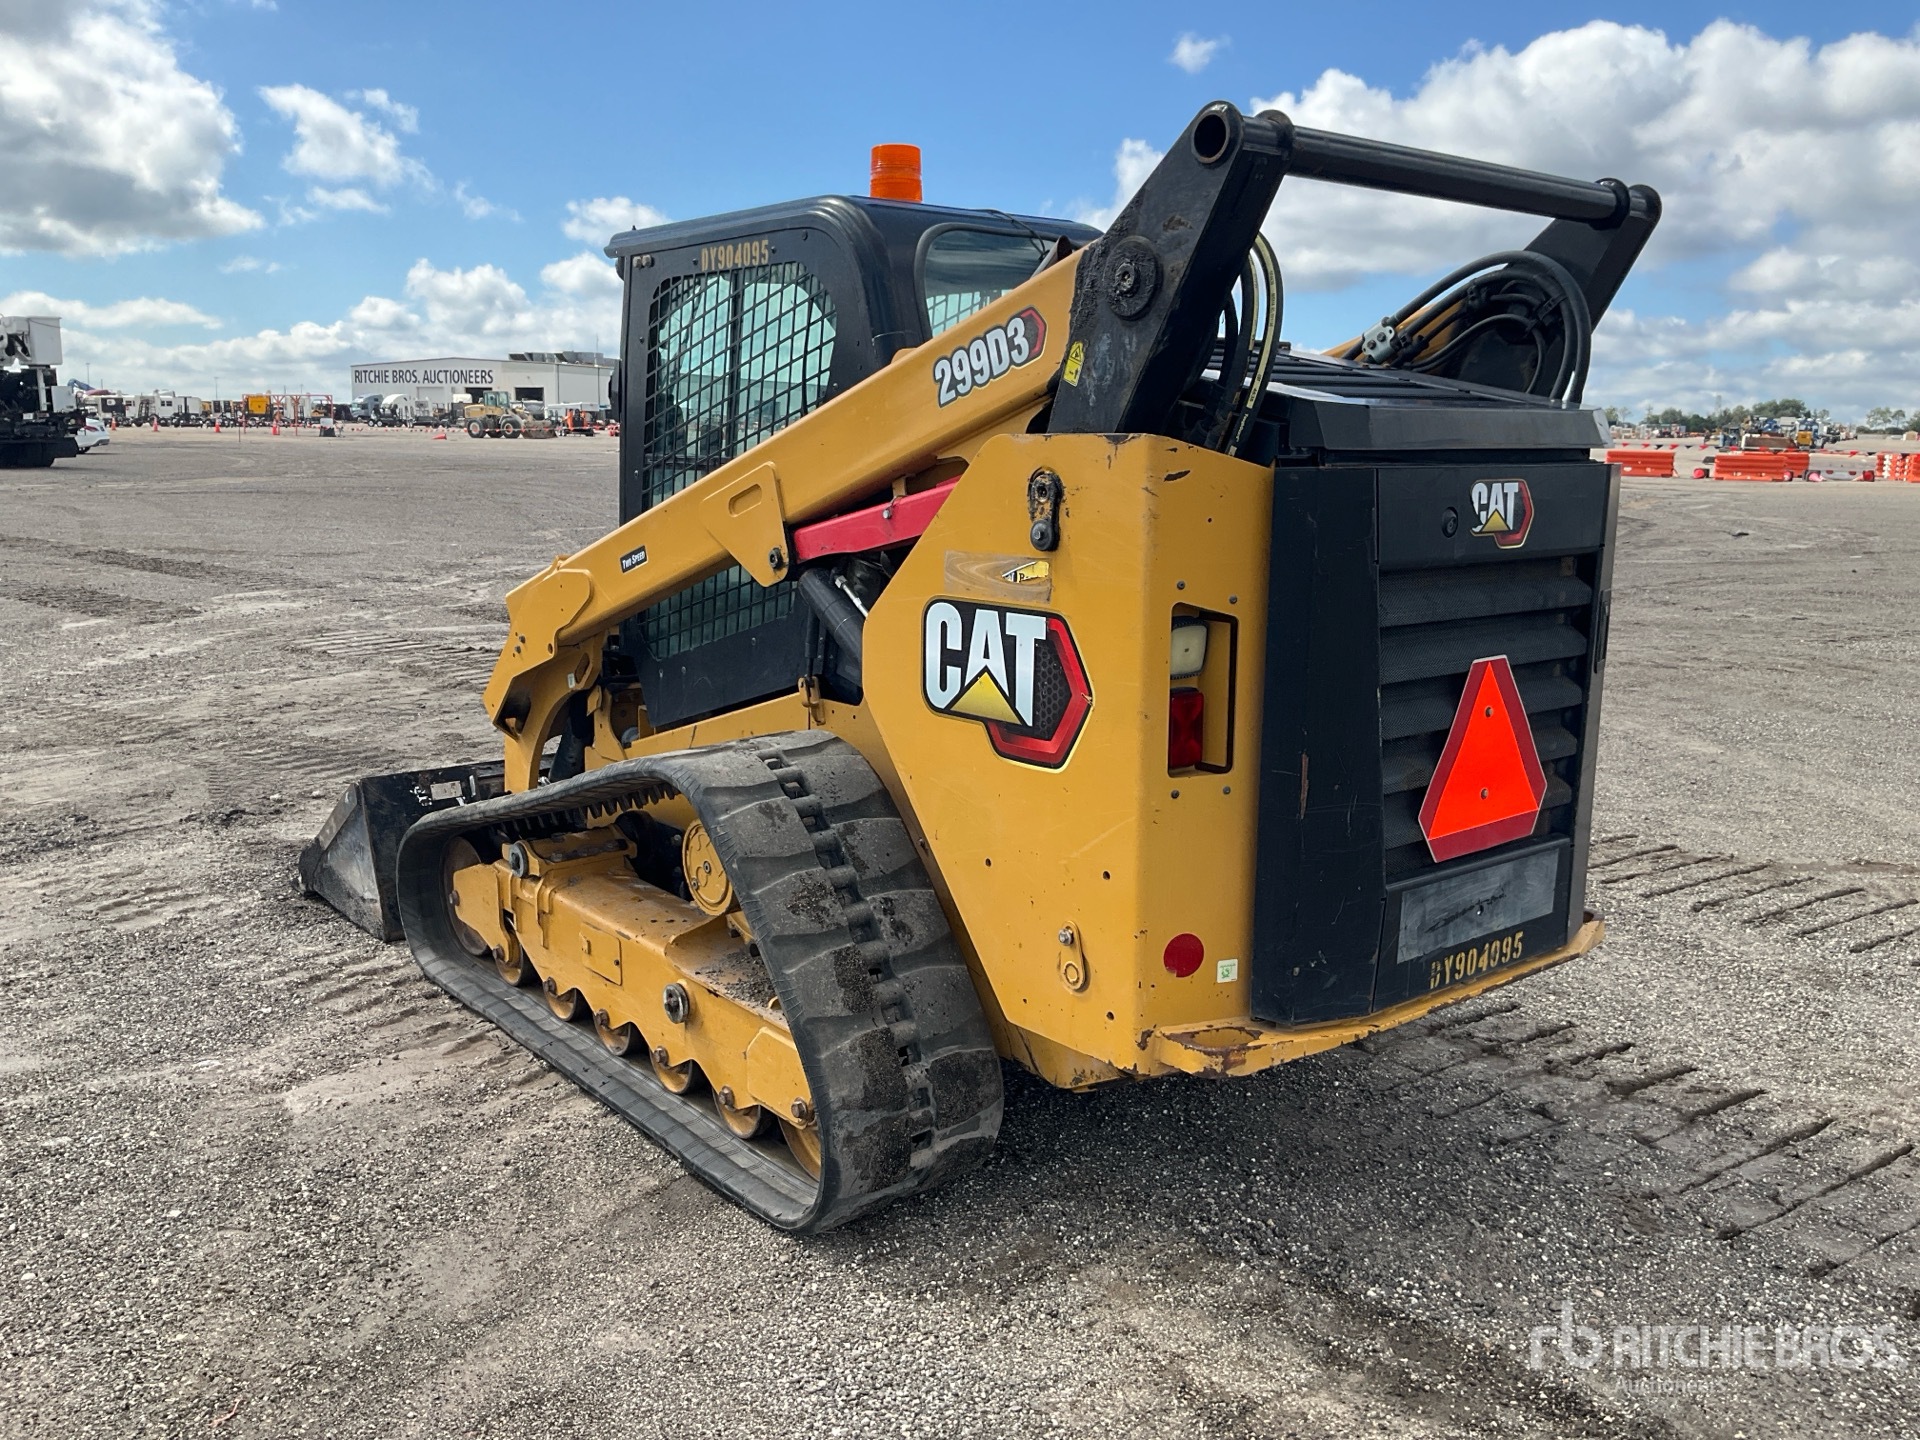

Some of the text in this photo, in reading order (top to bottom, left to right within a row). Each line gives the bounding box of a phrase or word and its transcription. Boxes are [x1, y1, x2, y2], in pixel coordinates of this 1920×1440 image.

[701, 239, 769, 272] DY904095
[354, 369, 494, 385] RITCHIE BROS. AUCTIONEERS
[934, 317, 1030, 405] 299D3
[1471, 482, 1519, 533] CAT
[926, 602, 1047, 727] CAT
